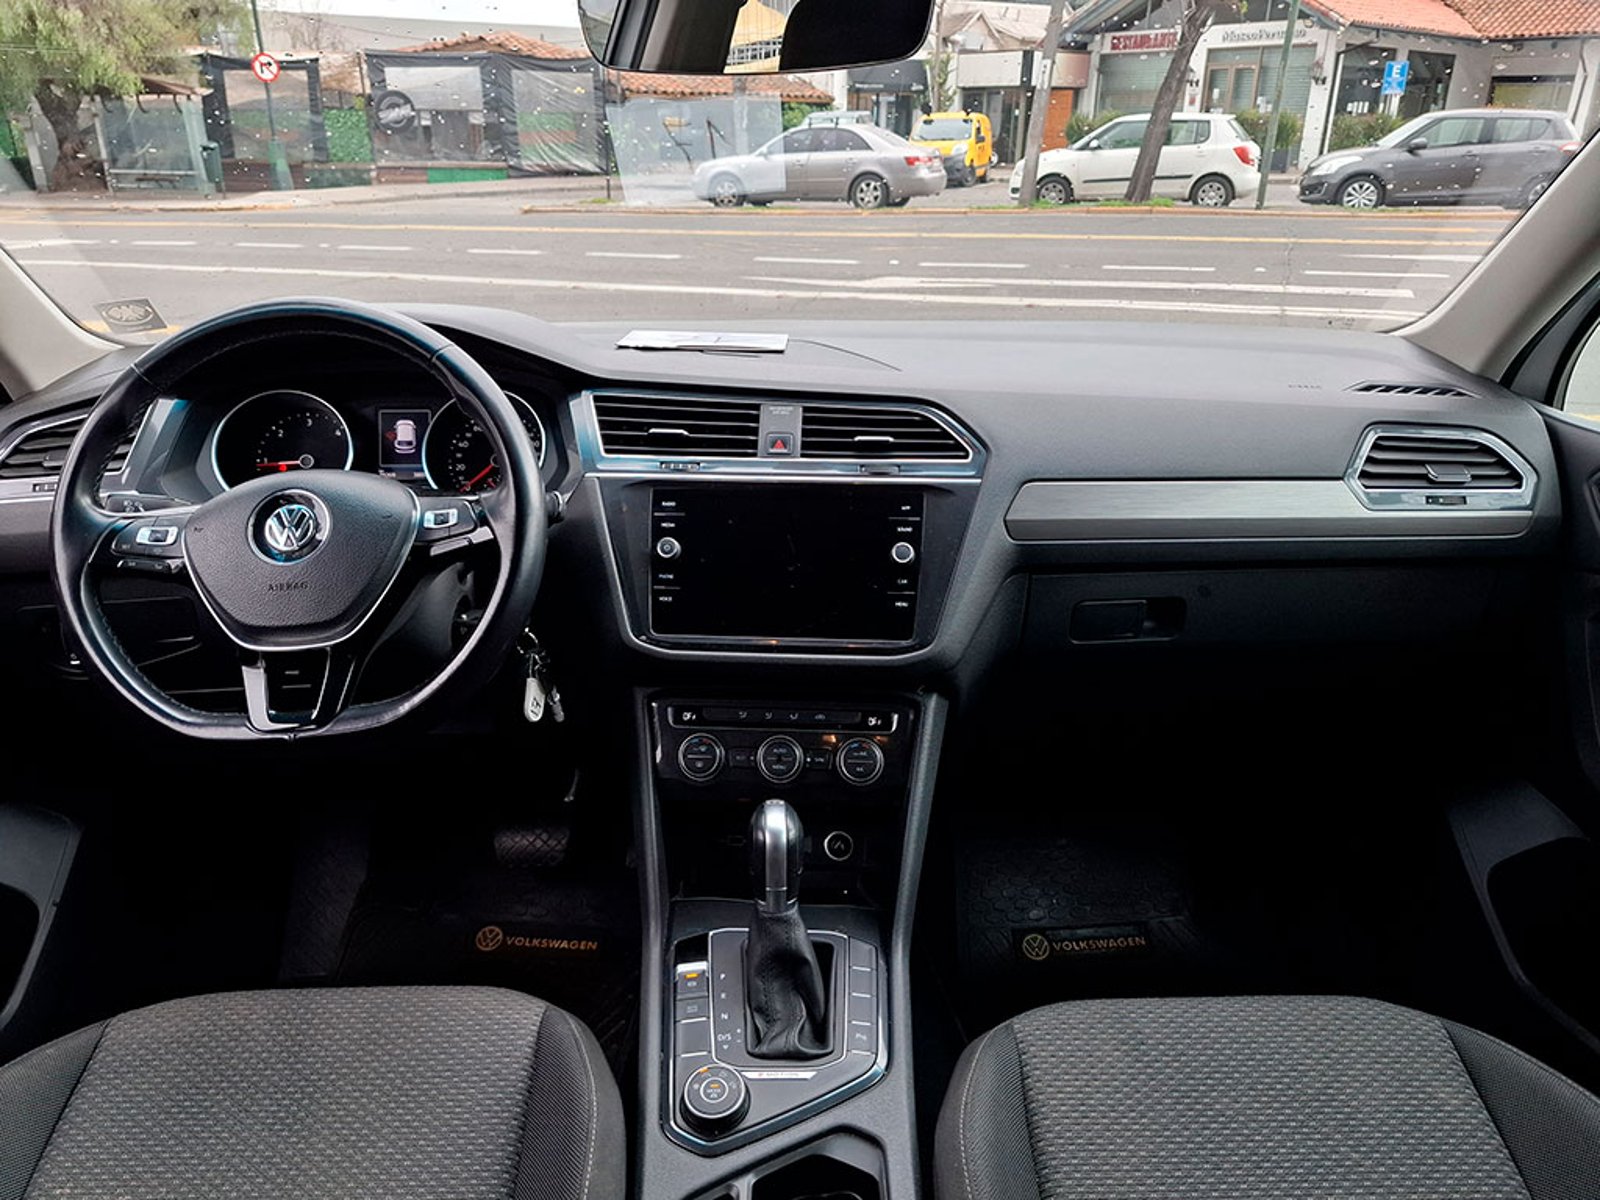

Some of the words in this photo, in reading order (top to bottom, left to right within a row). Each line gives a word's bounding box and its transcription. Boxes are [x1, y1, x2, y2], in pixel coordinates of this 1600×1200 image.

[1392, 65, 1401, 77] E
[268, 581, 309, 592] AIRBAG
[506, 936, 598, 950] VOLKSWAGEN
[1052, 936, 1146, 951] VOLKSWAGEN
